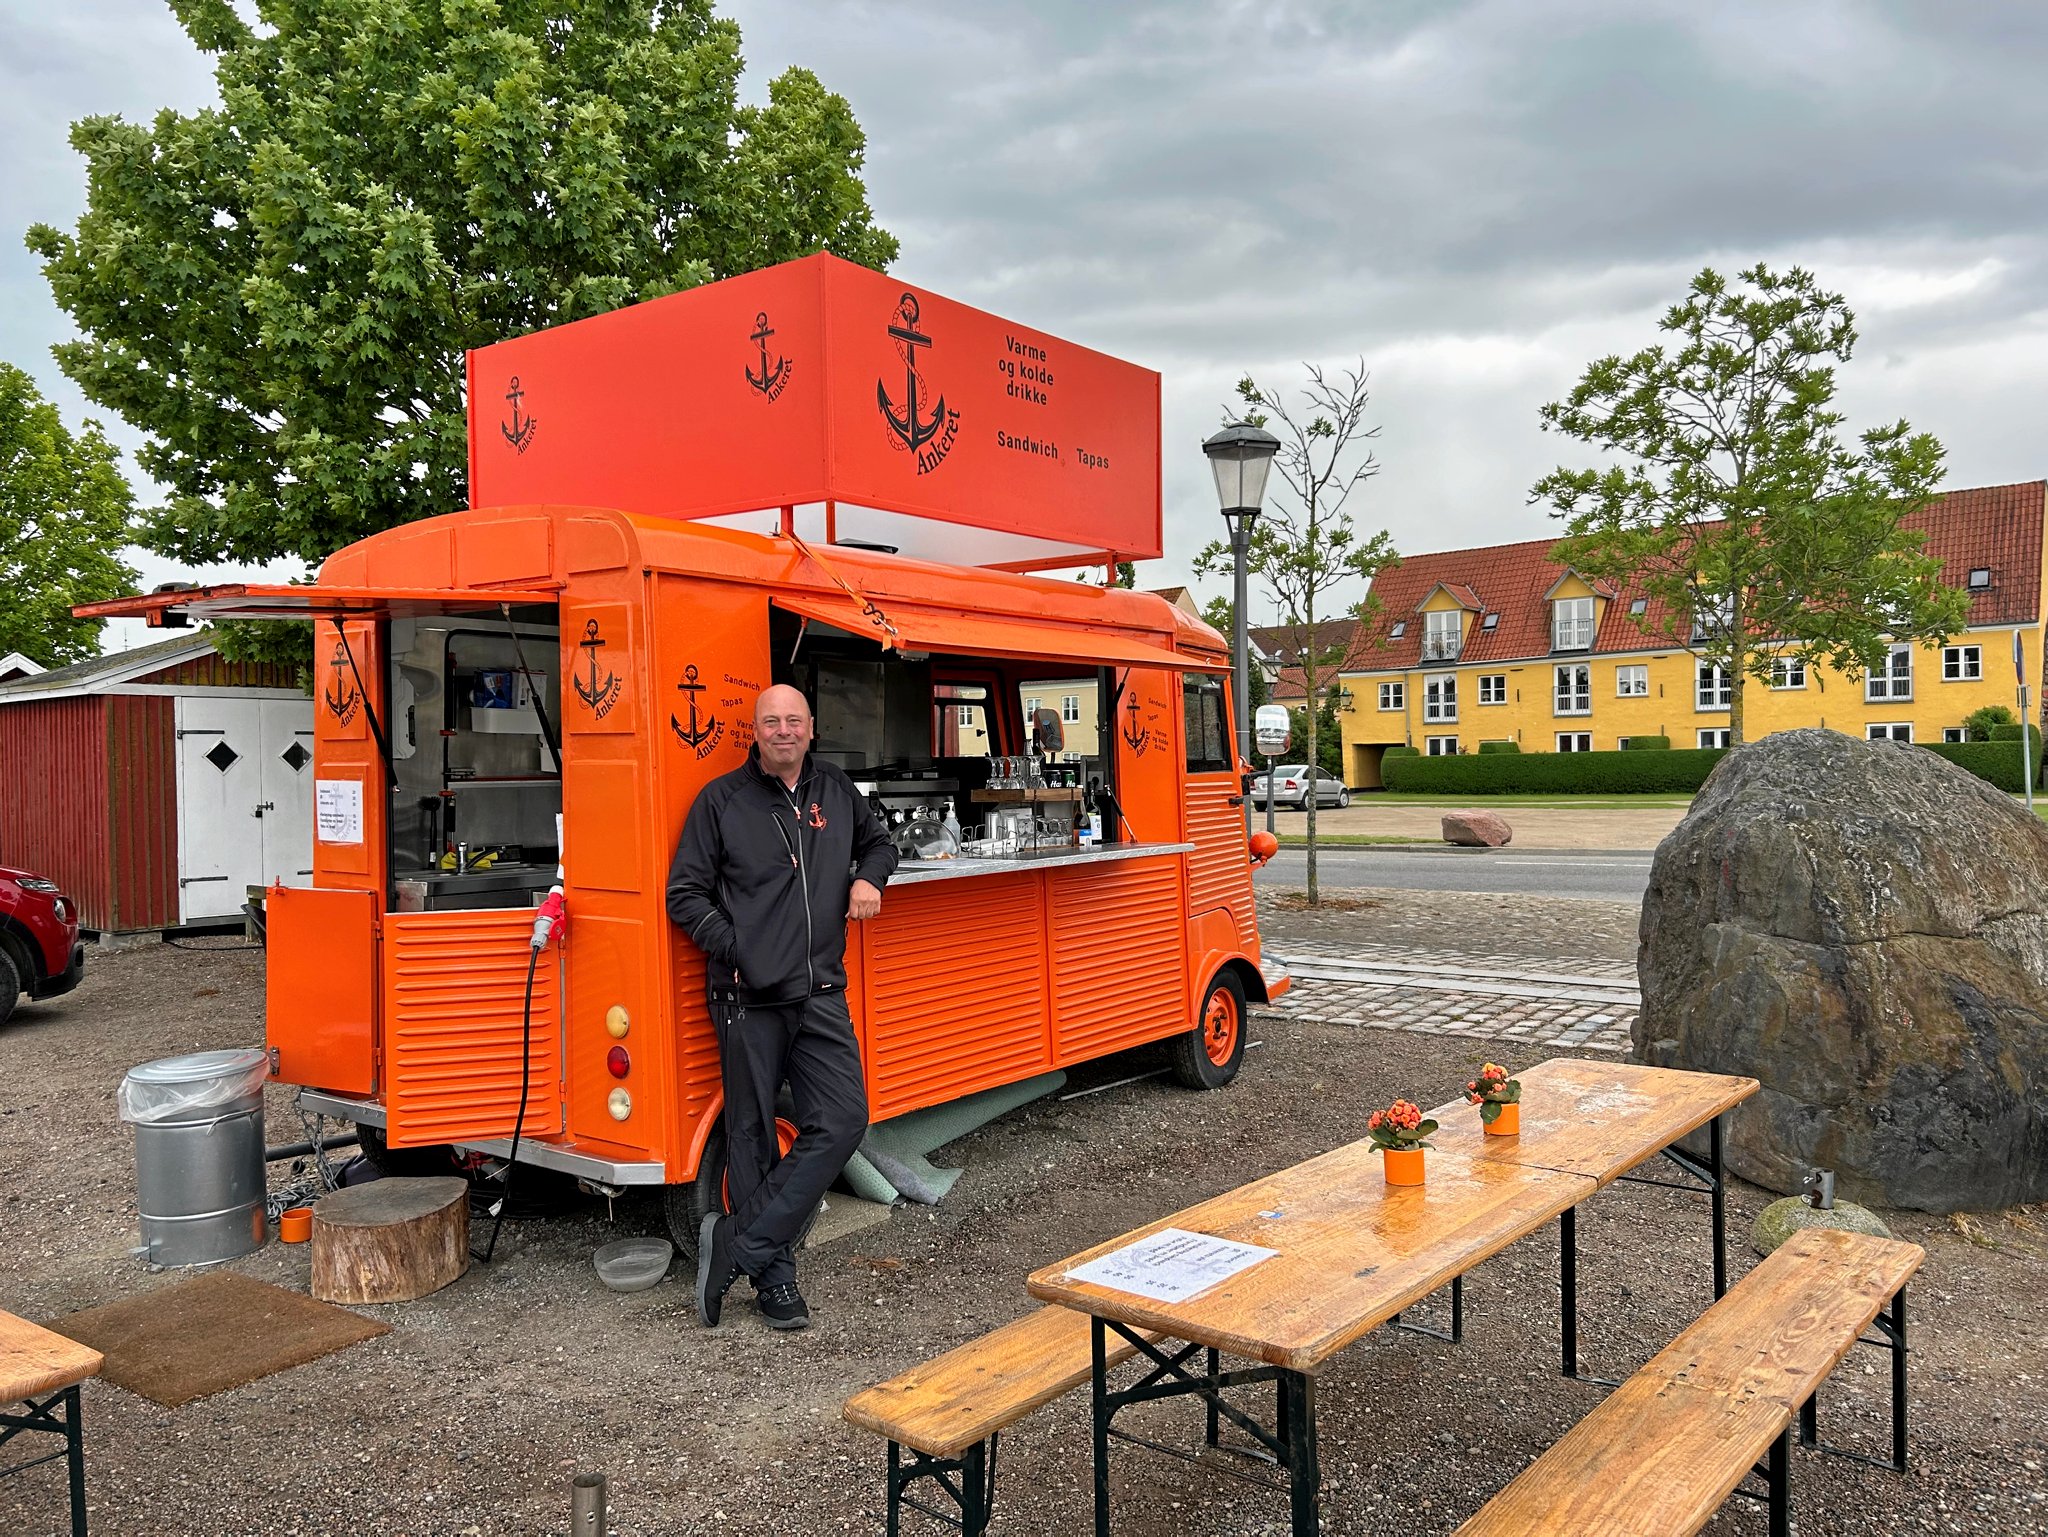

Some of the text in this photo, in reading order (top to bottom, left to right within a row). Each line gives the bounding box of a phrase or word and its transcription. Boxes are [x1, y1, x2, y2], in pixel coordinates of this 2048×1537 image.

[1006, 335, 1047, 363] Varme
[768, 358, 793, 404] Ankeret
[998, 358, 1054, 386] og kolde
[1006, 380, 1048, 406] drikke
[517, 418, 537, 456] Ankeret
[917, 408, 961, 476] Ankeret
[998, 430, 1110, 470] Sandwich Tapas
[723, 673, 761, 692] Sandwich
[341, 691, 361, 729] Ankeret
[595, 676, 623, 721] Ankeret
[721, 697, 744, 708] Tapas
[730, 729, 755, 742] og kol
[735, 718, 755, 731] Varm
[696, 720, 726, 760] Ankeret
[733, 740, 749, 751] drik
